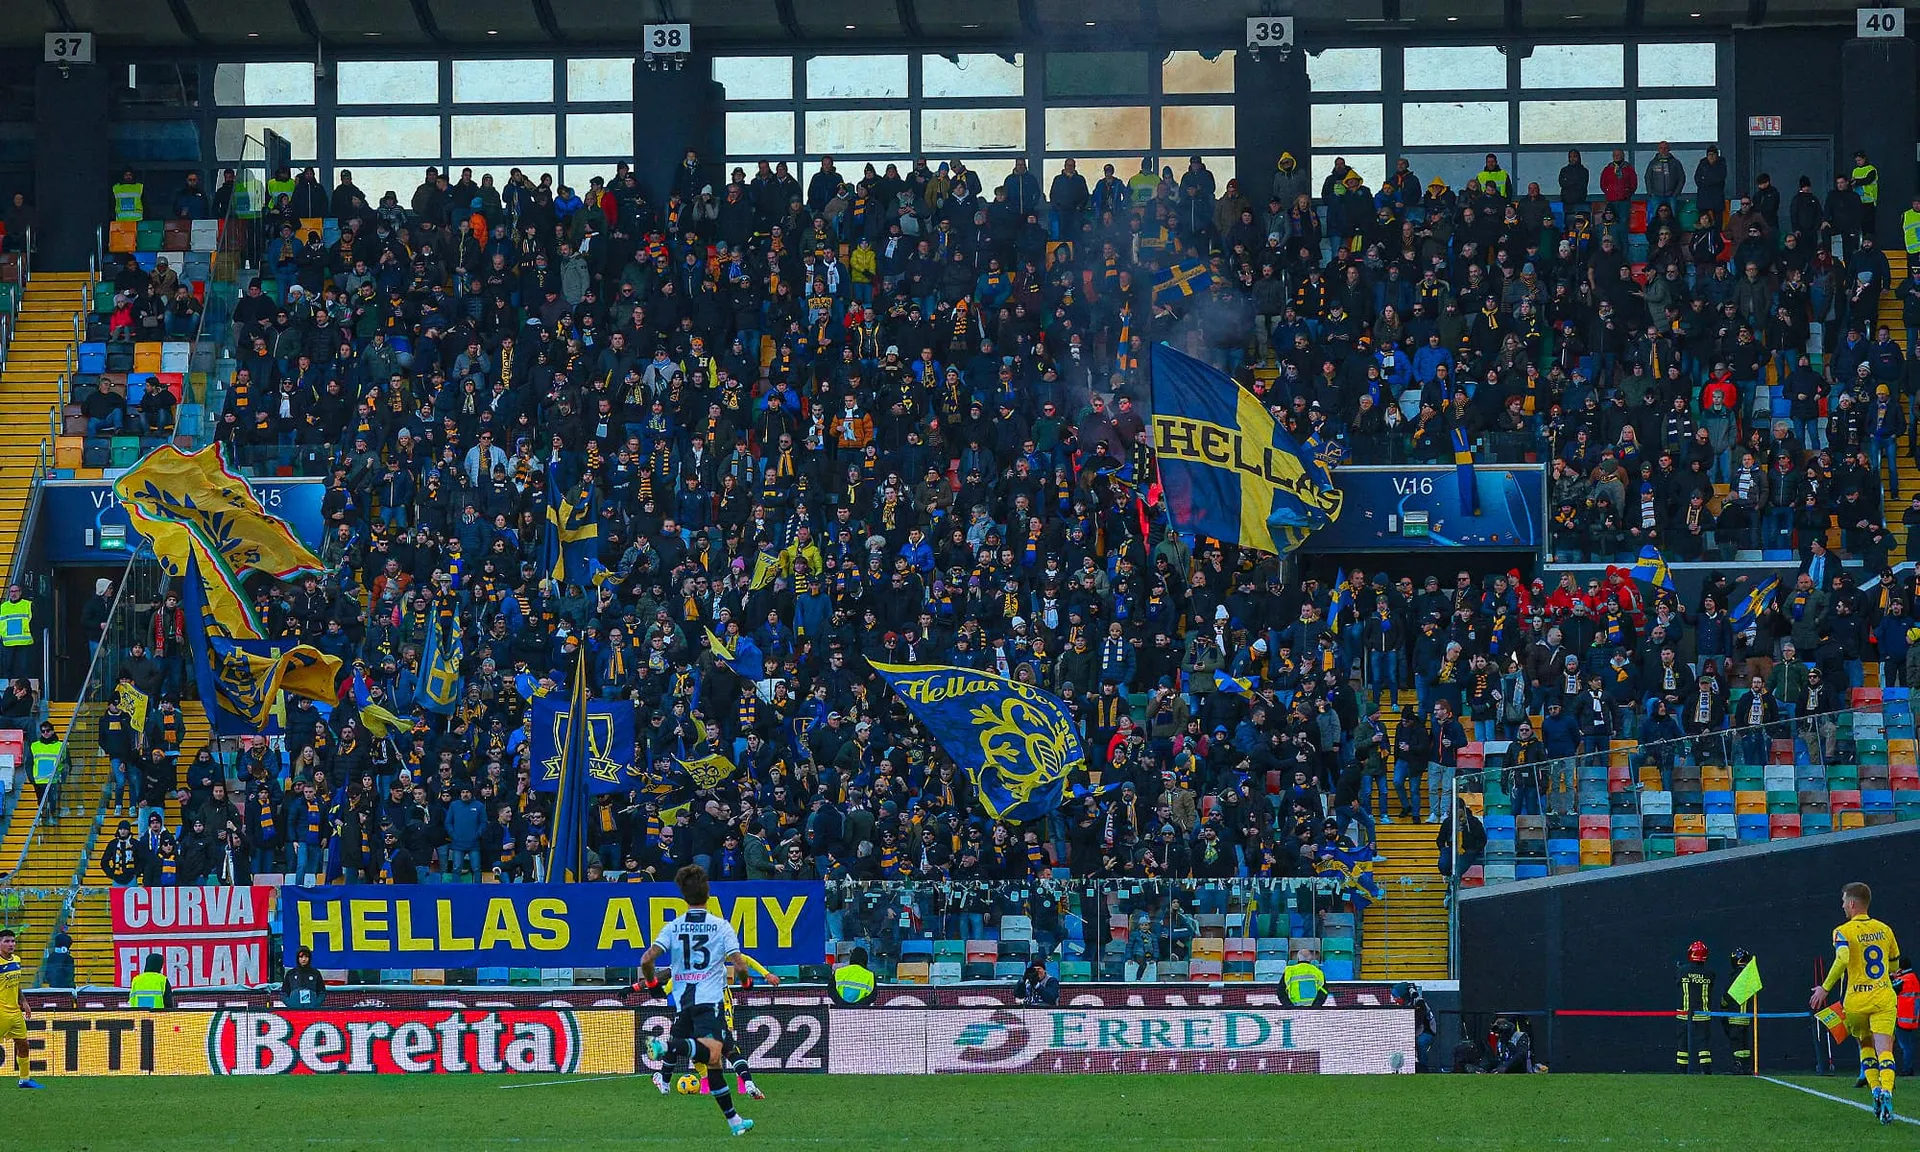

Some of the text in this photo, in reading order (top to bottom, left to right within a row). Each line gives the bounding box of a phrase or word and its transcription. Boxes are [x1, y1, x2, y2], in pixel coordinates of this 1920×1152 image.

[653, 29, 682, 47] 38
[1256, 22, 1284, 41] 39
[1866, 13, 1895, 31] 40
[54, 38, 82, 57] 37
[894, 675, 999, 704] Hellas
[123, 886, 255, 928] CURVA
[297, 897, 570, 952] HELLAS
[678, 934, 711, 970] 13
[1863, 944, 1885, 979] 8
[229, 1011, 564, 1074] Beretta
